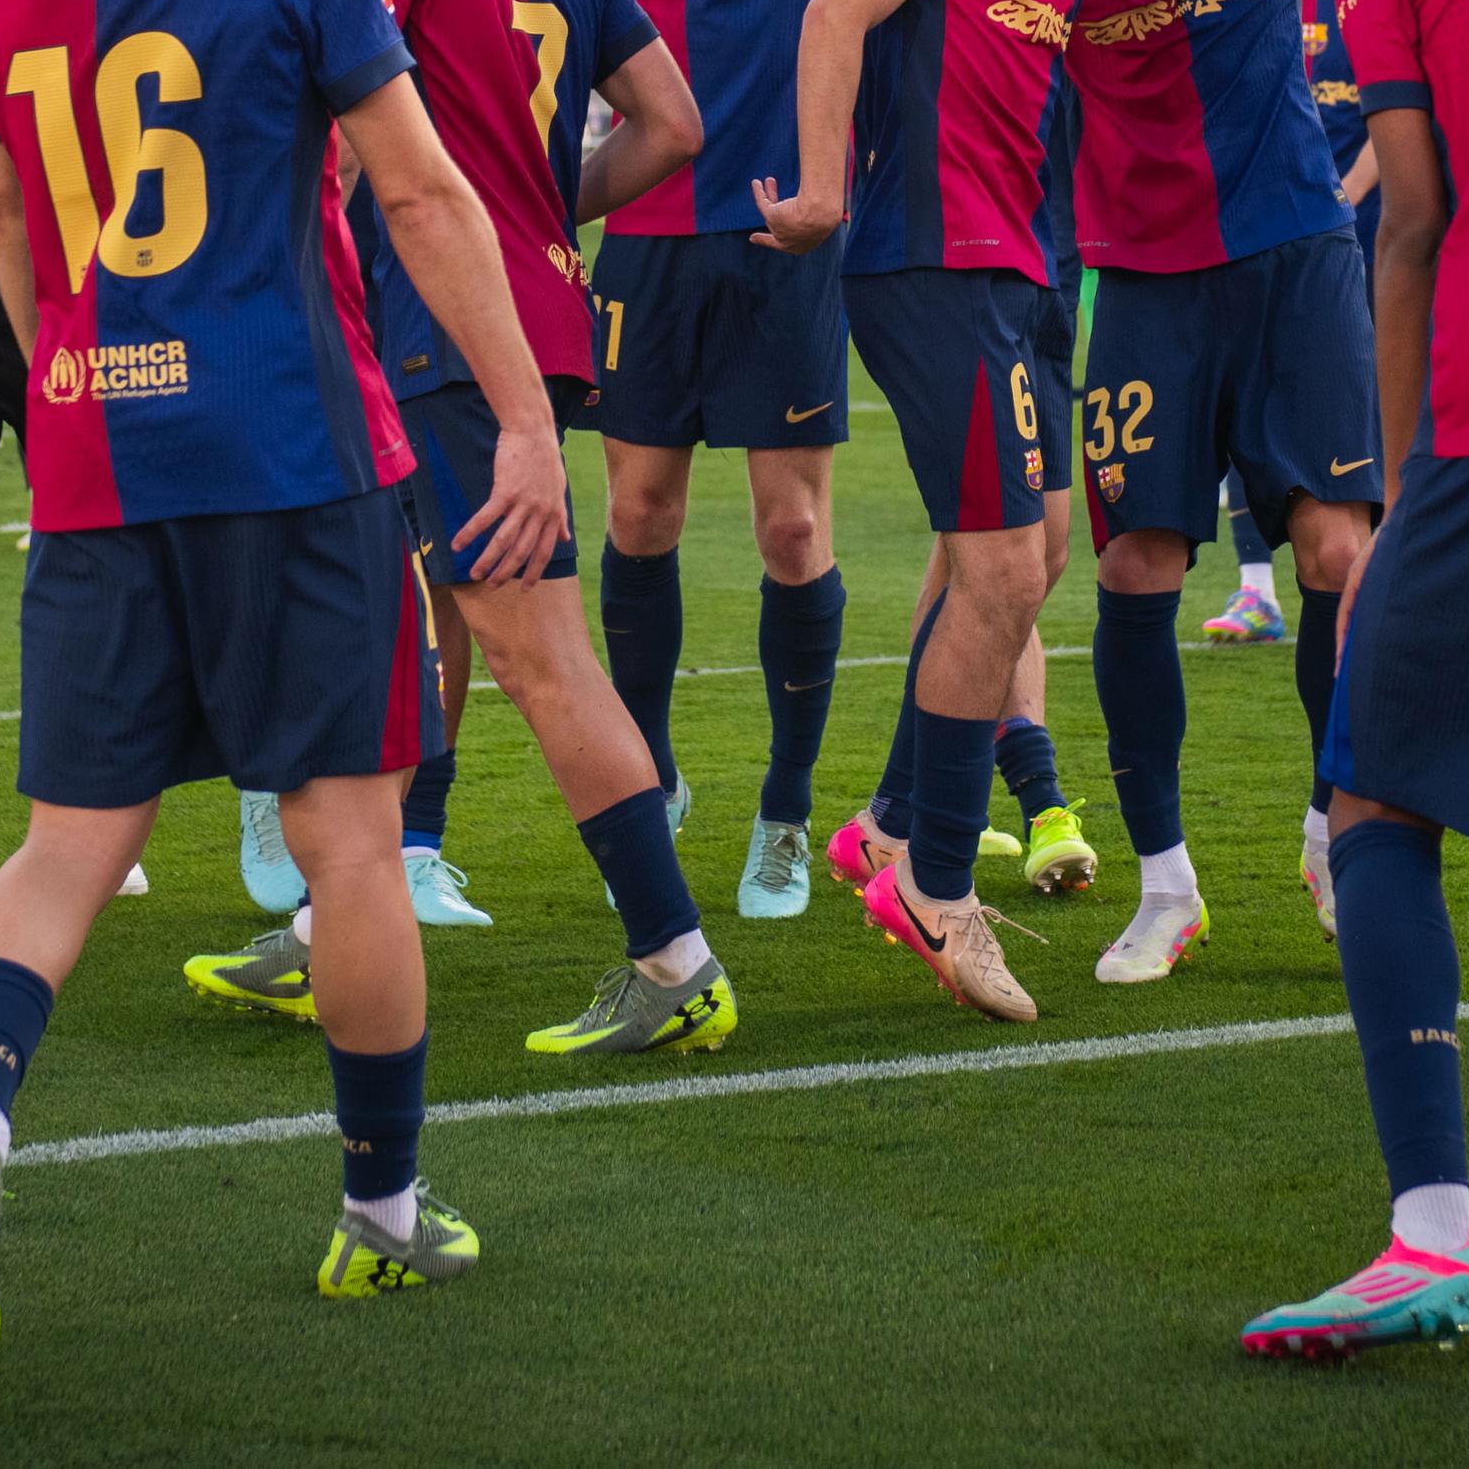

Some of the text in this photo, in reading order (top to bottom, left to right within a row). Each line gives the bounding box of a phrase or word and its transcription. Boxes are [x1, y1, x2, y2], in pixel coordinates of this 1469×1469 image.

[511, 1, 568, 155] 7
[6, 31, 208, 295] 16
[87, 340, 187, 370] UNHCR
[89, 362, 188, 391] ACNUR
[1010, 361, 1037, 441] 6
[1085, 380, 1155, 461] 32
